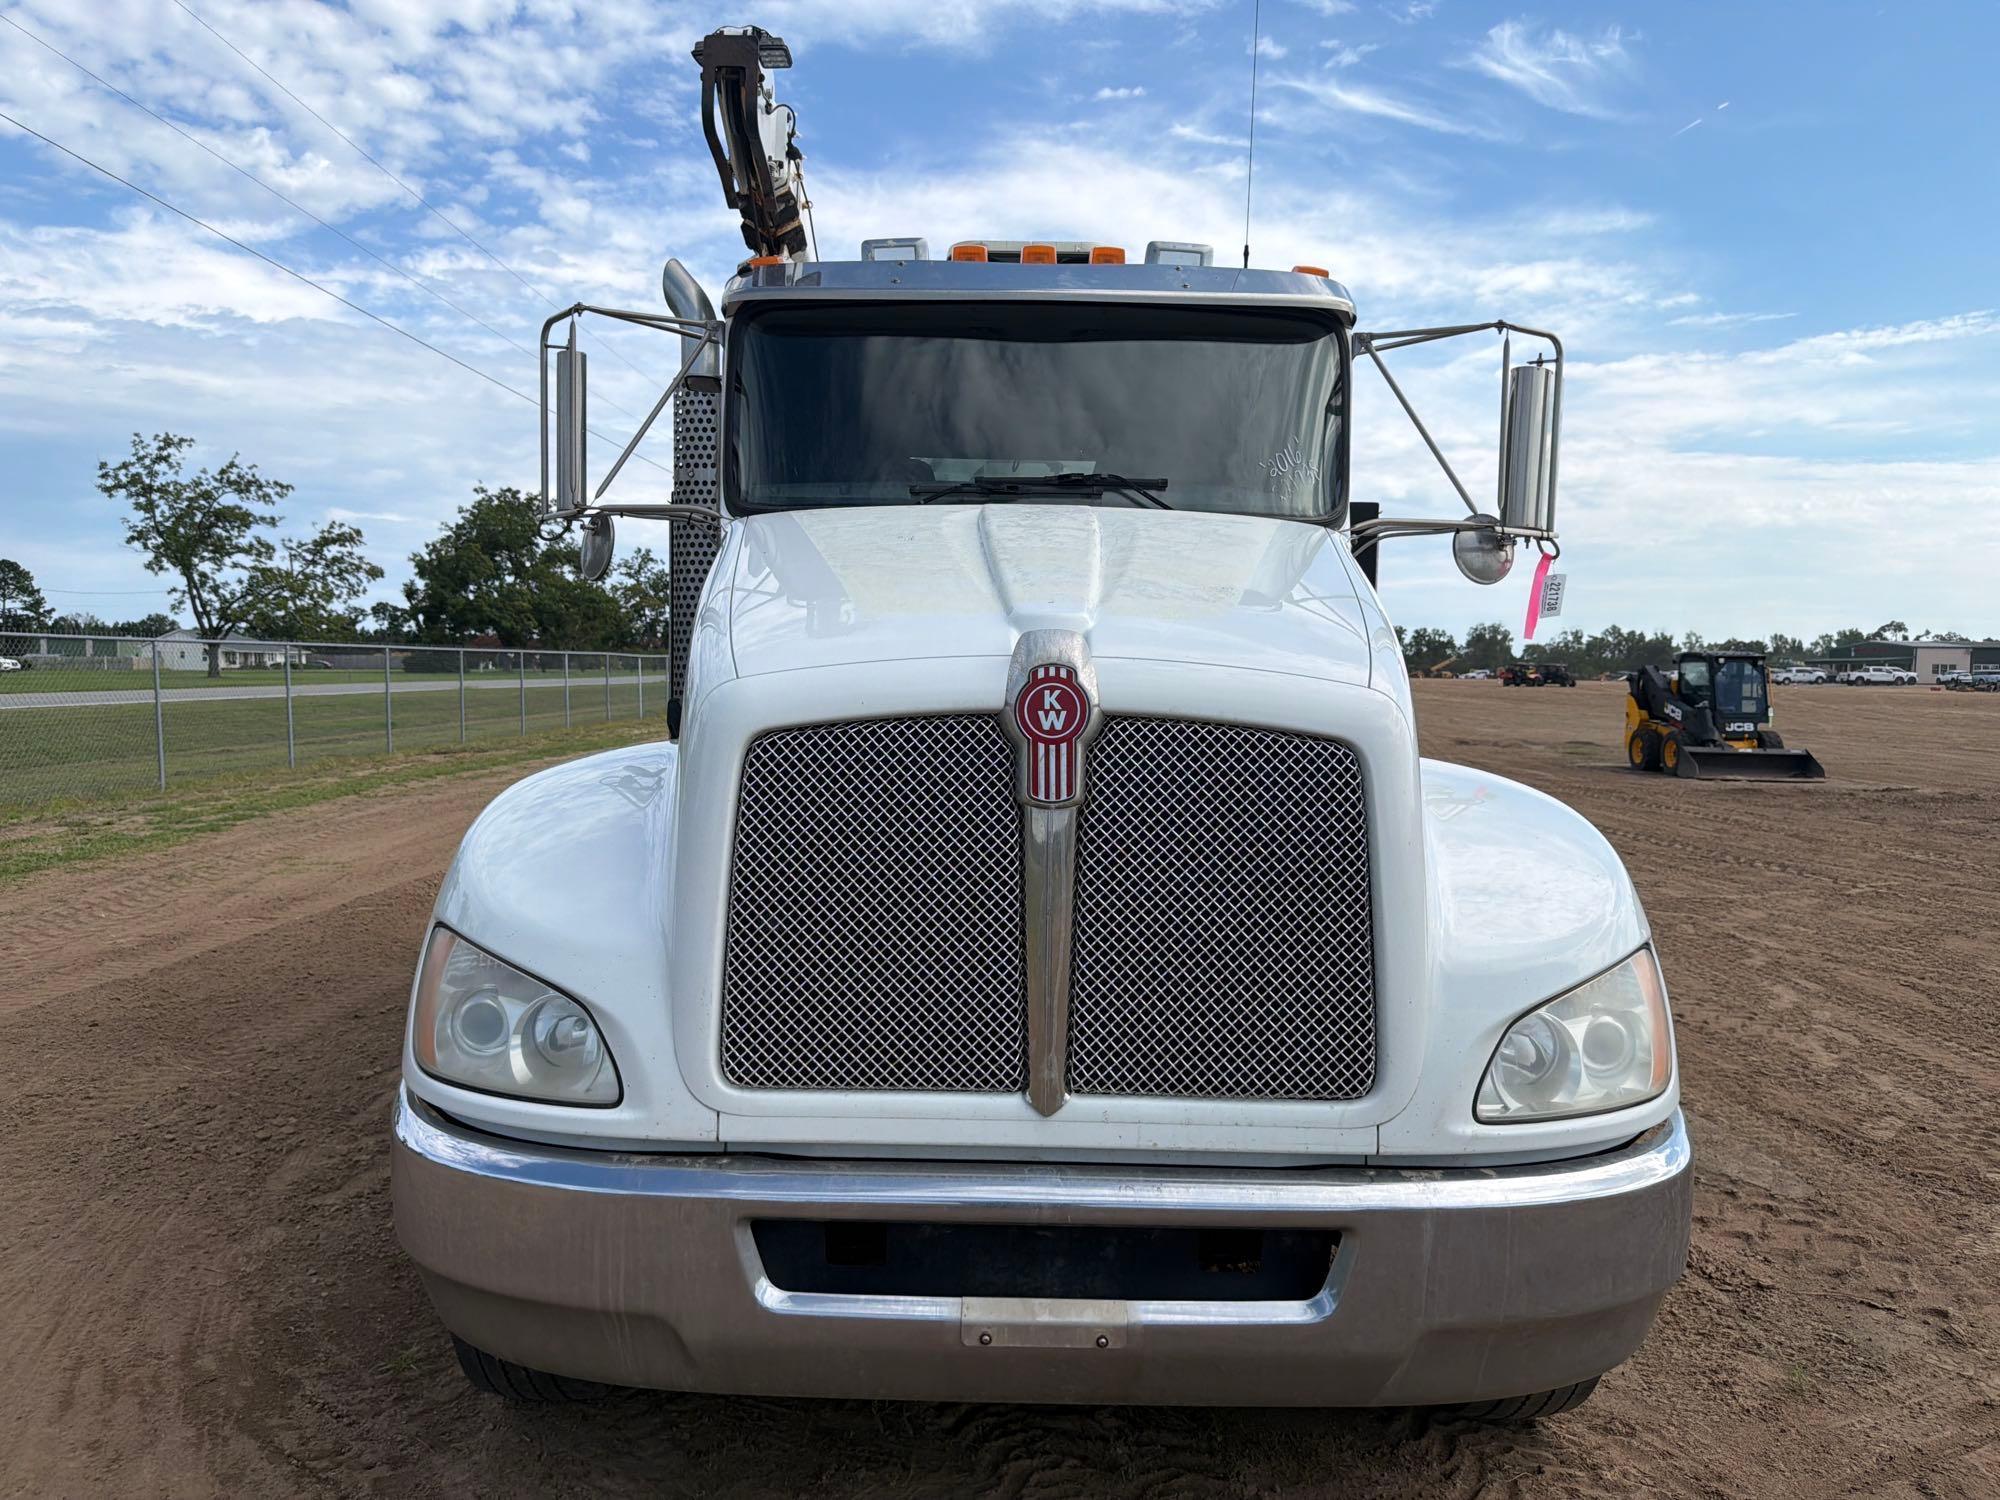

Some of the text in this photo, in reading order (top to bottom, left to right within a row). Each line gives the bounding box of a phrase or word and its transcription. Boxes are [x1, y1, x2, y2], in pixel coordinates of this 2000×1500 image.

[1546, 581, 1562, 612] 221738
[1663, 702, 1683, 721] JCB
[1725, 722, 1755, 732] JCB
